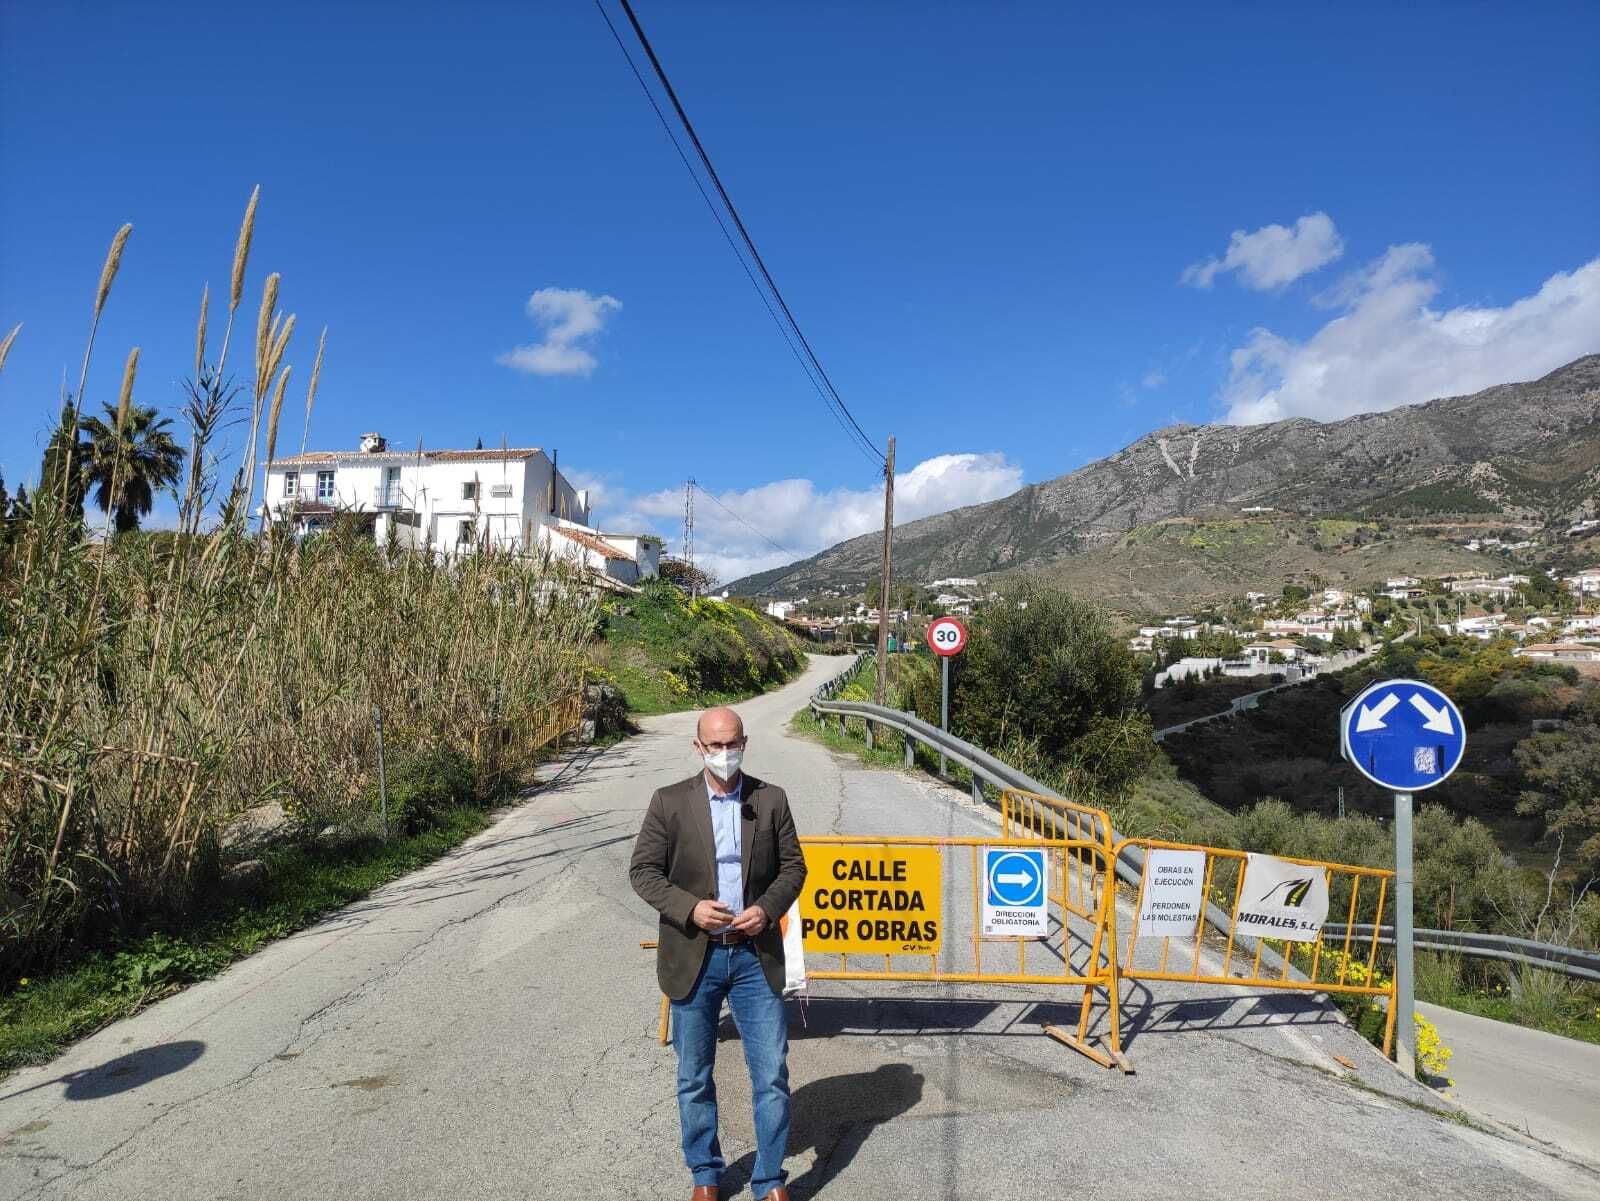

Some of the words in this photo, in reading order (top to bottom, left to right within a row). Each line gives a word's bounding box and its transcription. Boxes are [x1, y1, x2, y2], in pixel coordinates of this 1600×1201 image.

[936, 630, 957, 642] 30
[832, 860, 907, 881] CALLE
[1157, 866, 1182, 874] OBRAS
[1183, 866, 1194, 874] EN
[1154, 878, 1194, 886] EJECUCIÓN
[814, 889, 925, 911] CORTADA
[1152, 902, 1191, 910] PERDONEN
[991, 918, 1040, 926] OBLIGATORIA
[1157, 914, 1197, 922] MOLESTIAS
[802, 918, 849, 940] POR
[857, 920, 937, 942] OBRAS
[1299, 921, 1319, 931] S.L.
